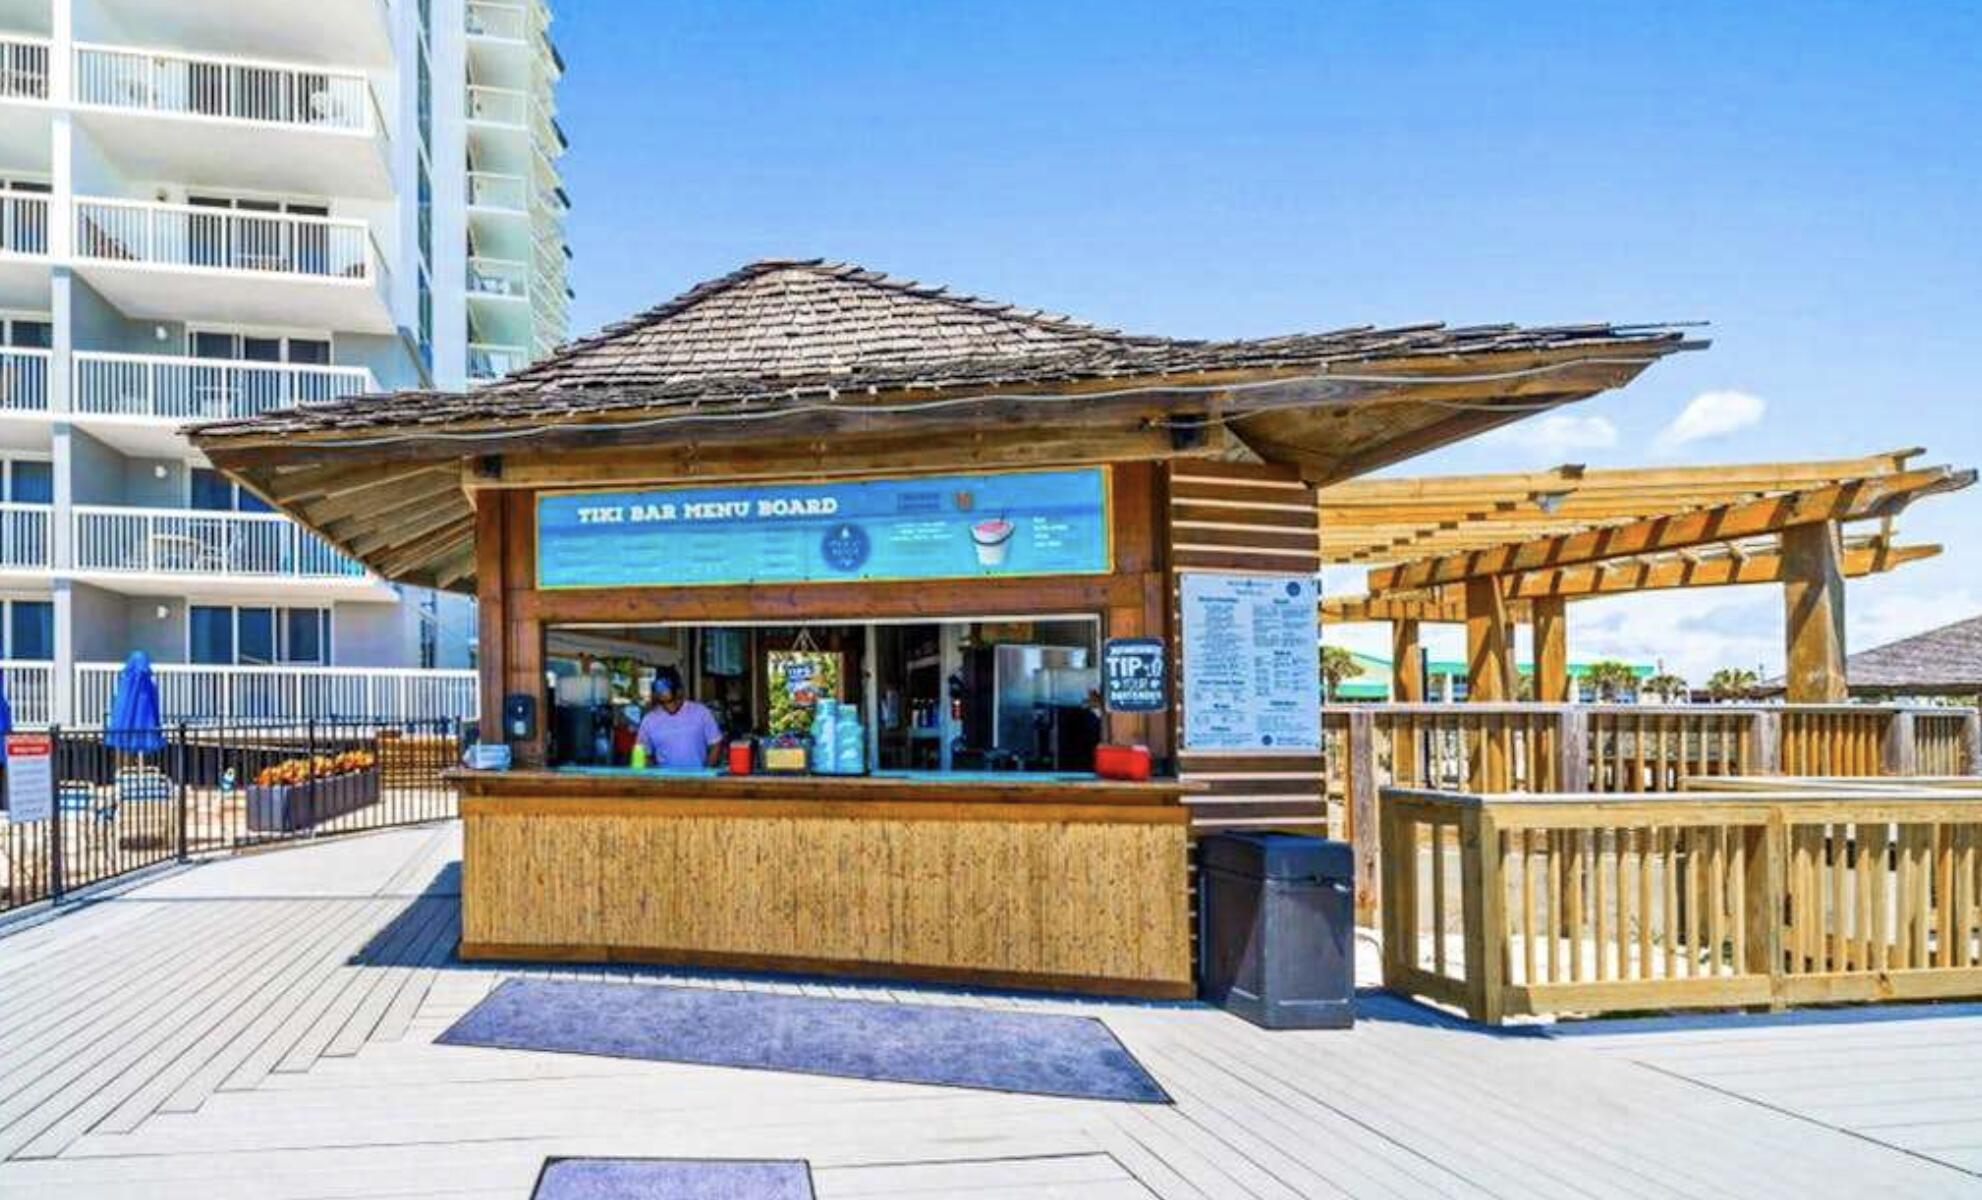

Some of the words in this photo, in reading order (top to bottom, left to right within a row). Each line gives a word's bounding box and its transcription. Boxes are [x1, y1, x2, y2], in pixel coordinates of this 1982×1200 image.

[577, 506, 624, 523] TIKI
[630, 504, 677, 521] BAR
[683, 501, 752, 519] MENU
[757, 497, 838, 517] BOARD
[1106, 656, 1143, 677] TIP
